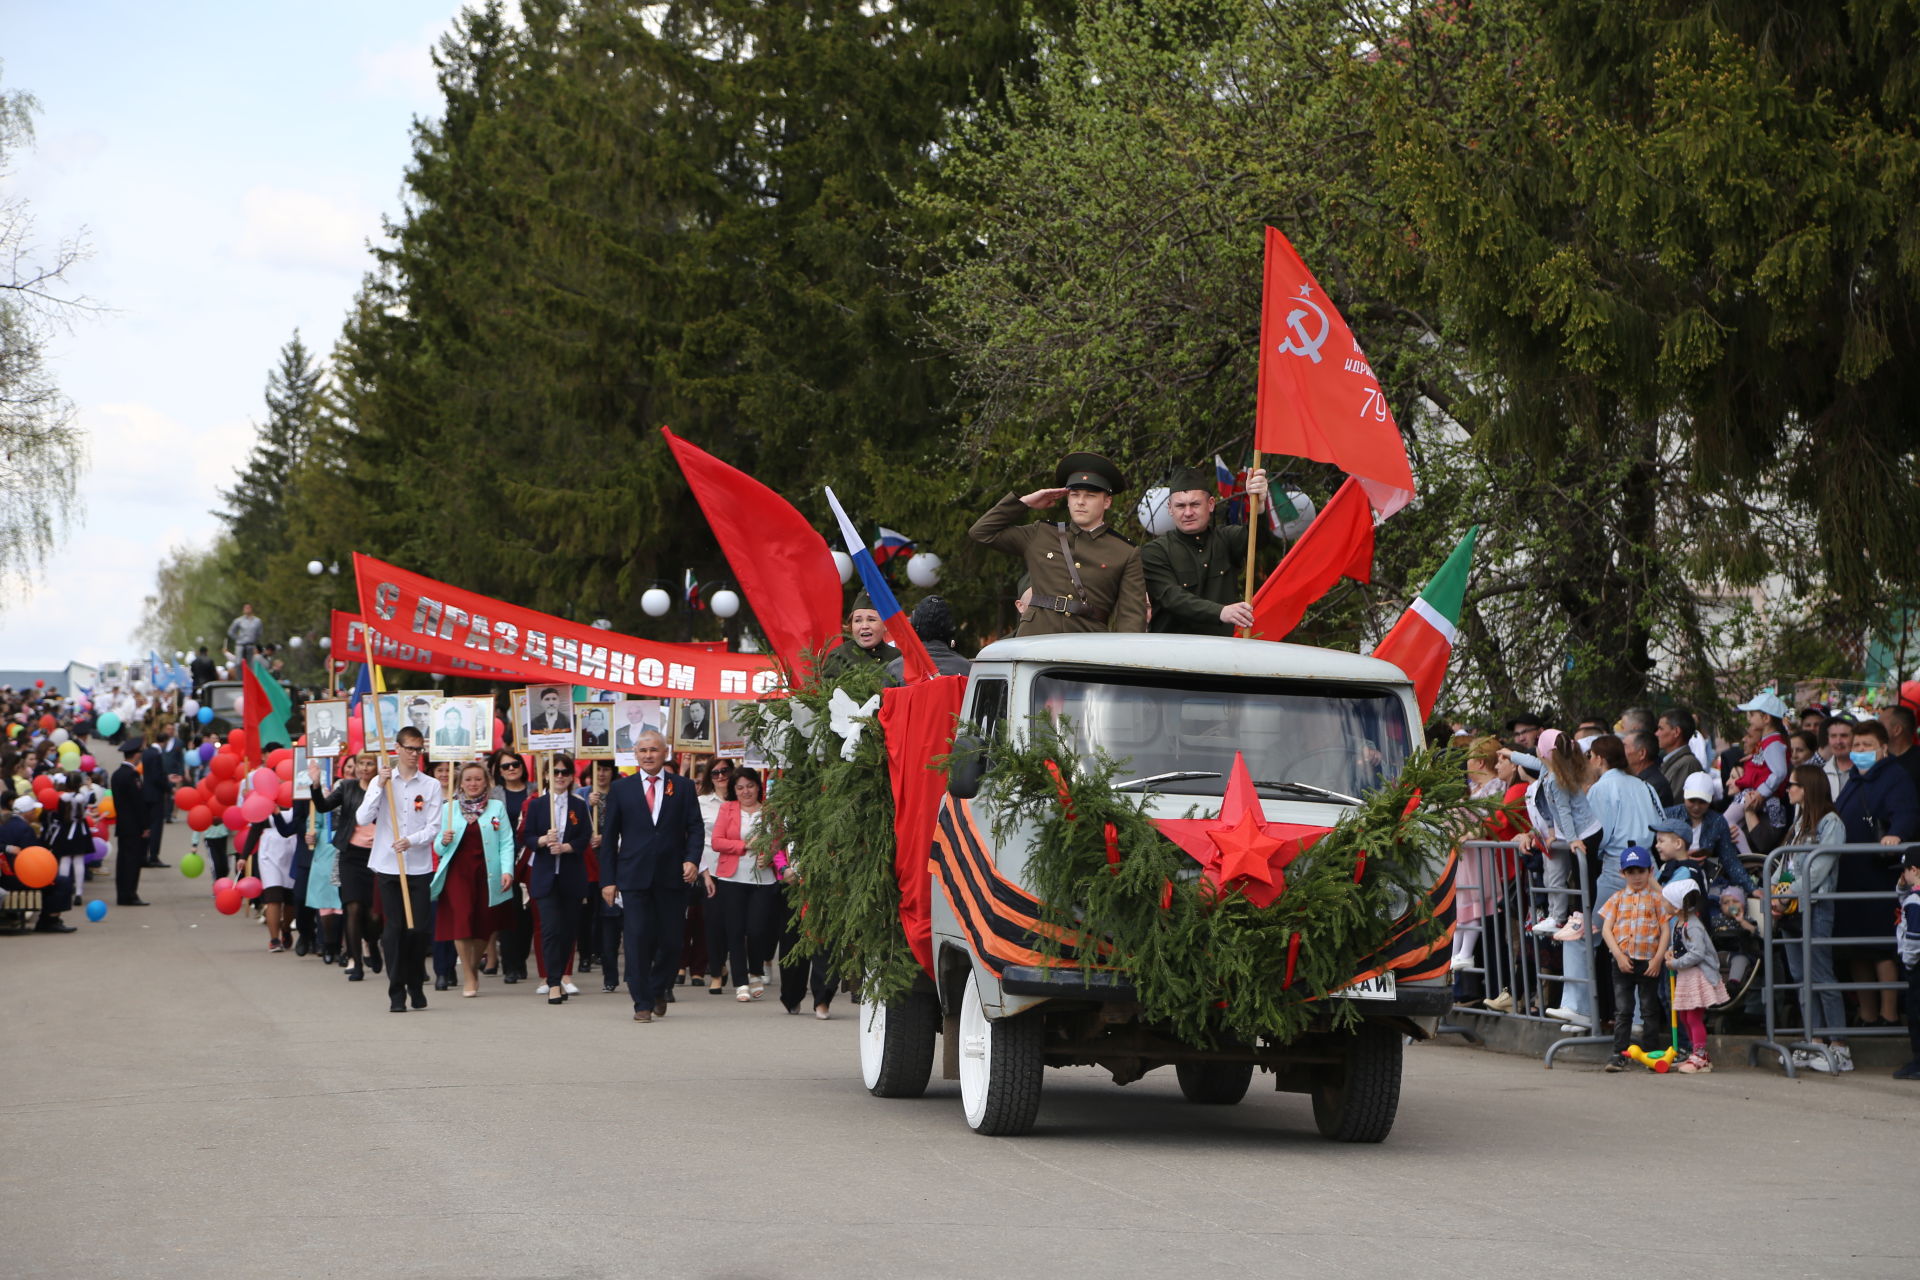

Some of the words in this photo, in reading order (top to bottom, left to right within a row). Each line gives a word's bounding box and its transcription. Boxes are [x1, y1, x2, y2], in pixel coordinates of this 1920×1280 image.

[1360, 387, 1387, 422] 79
[375, 582, 400, 620] С
[412, 596, 696, 691] ПРАЗДНИКОМ
